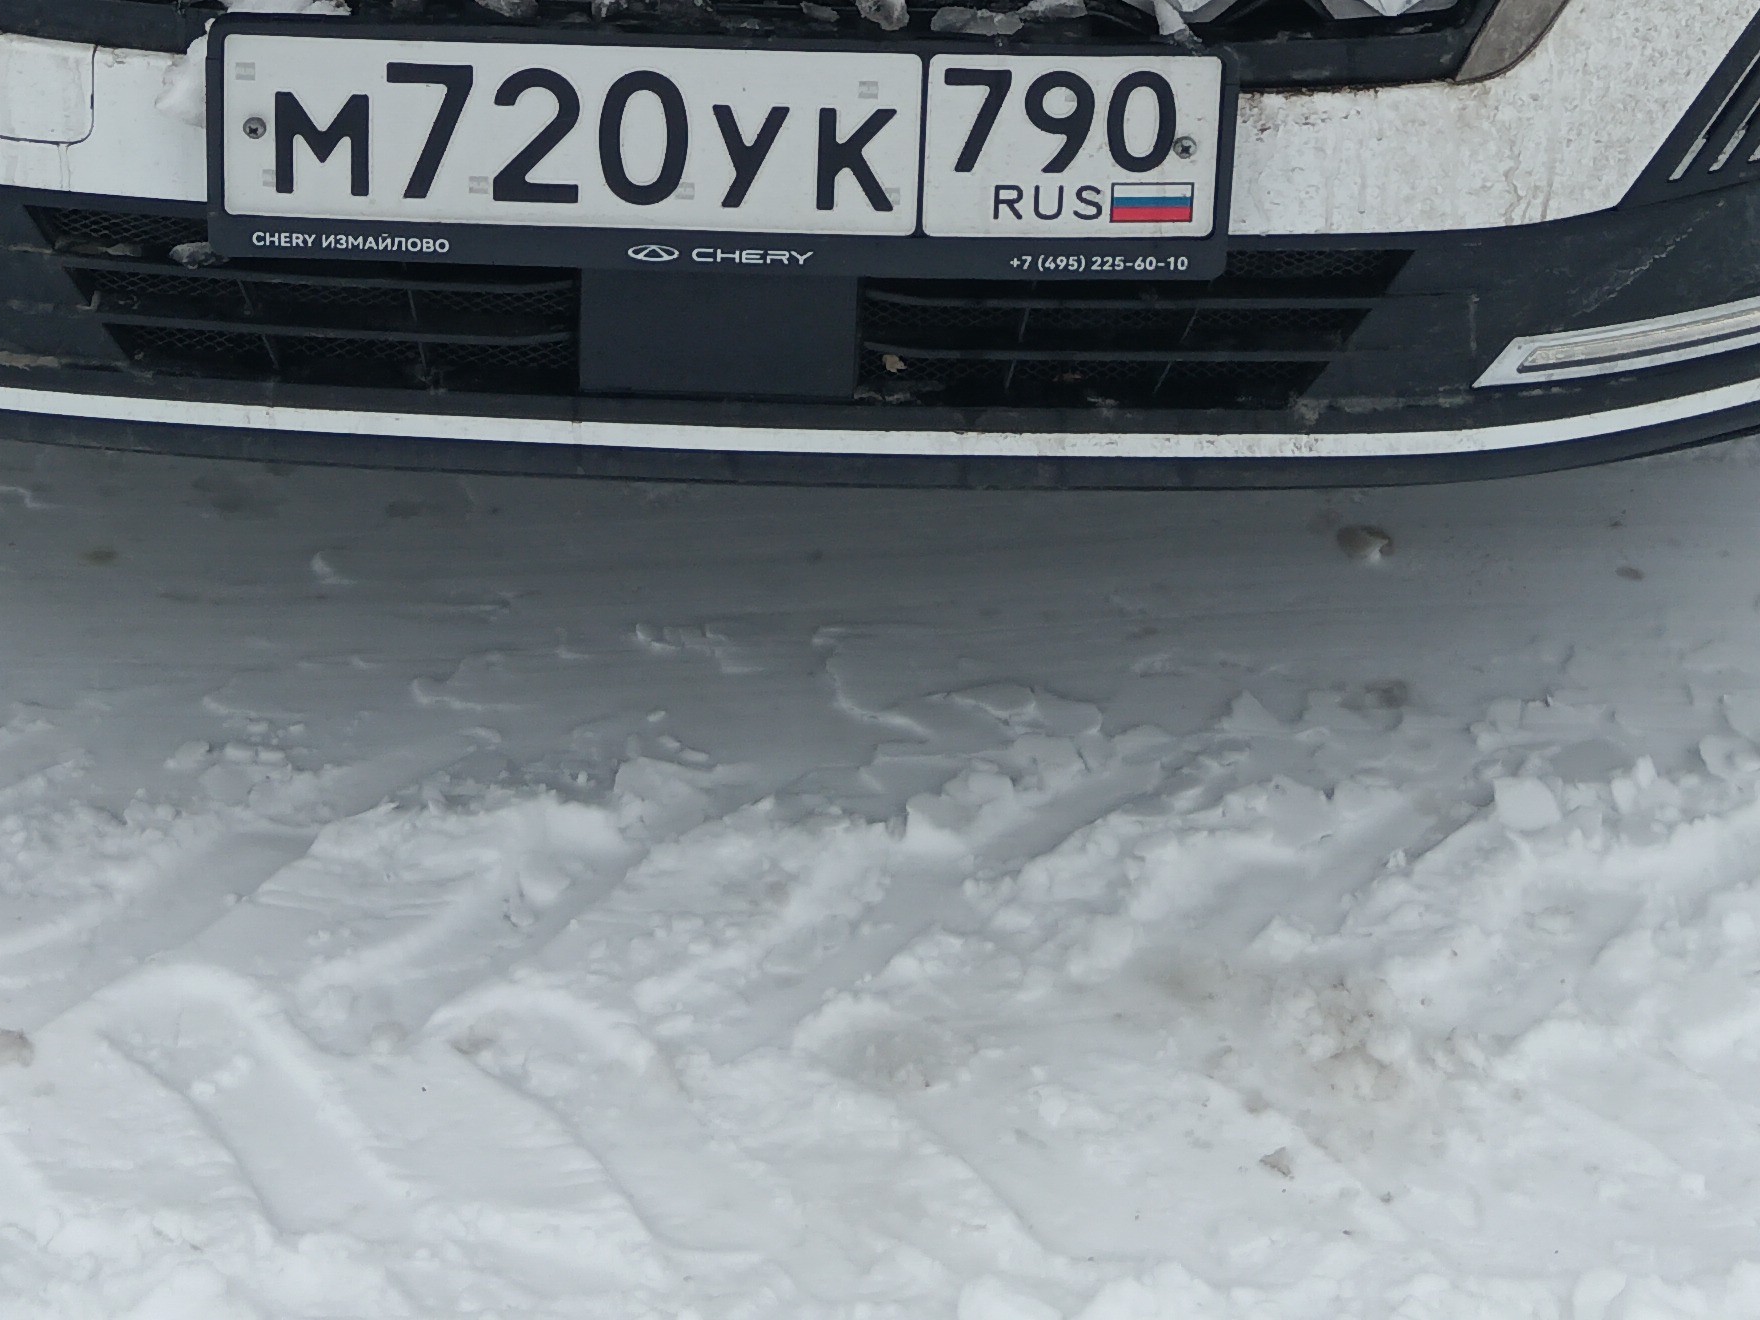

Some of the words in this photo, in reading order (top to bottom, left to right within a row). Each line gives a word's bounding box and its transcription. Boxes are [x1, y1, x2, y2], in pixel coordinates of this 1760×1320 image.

[274, 62, 898, 212] М720УК
[944, 67, 1177, 174] 790
[992, 184, 1103, 220] RUS
[252, 231, 317, 248] CHERY
[322, 232, 450, 253] ИЗМАЙЛОВО
[691, 248, 814, 265] CHERY
[1010, 255, 1032, 270] +7
[1037, 254, 1085, 271] (495)
[1090, 256, 1189, 271] 225-60-10
